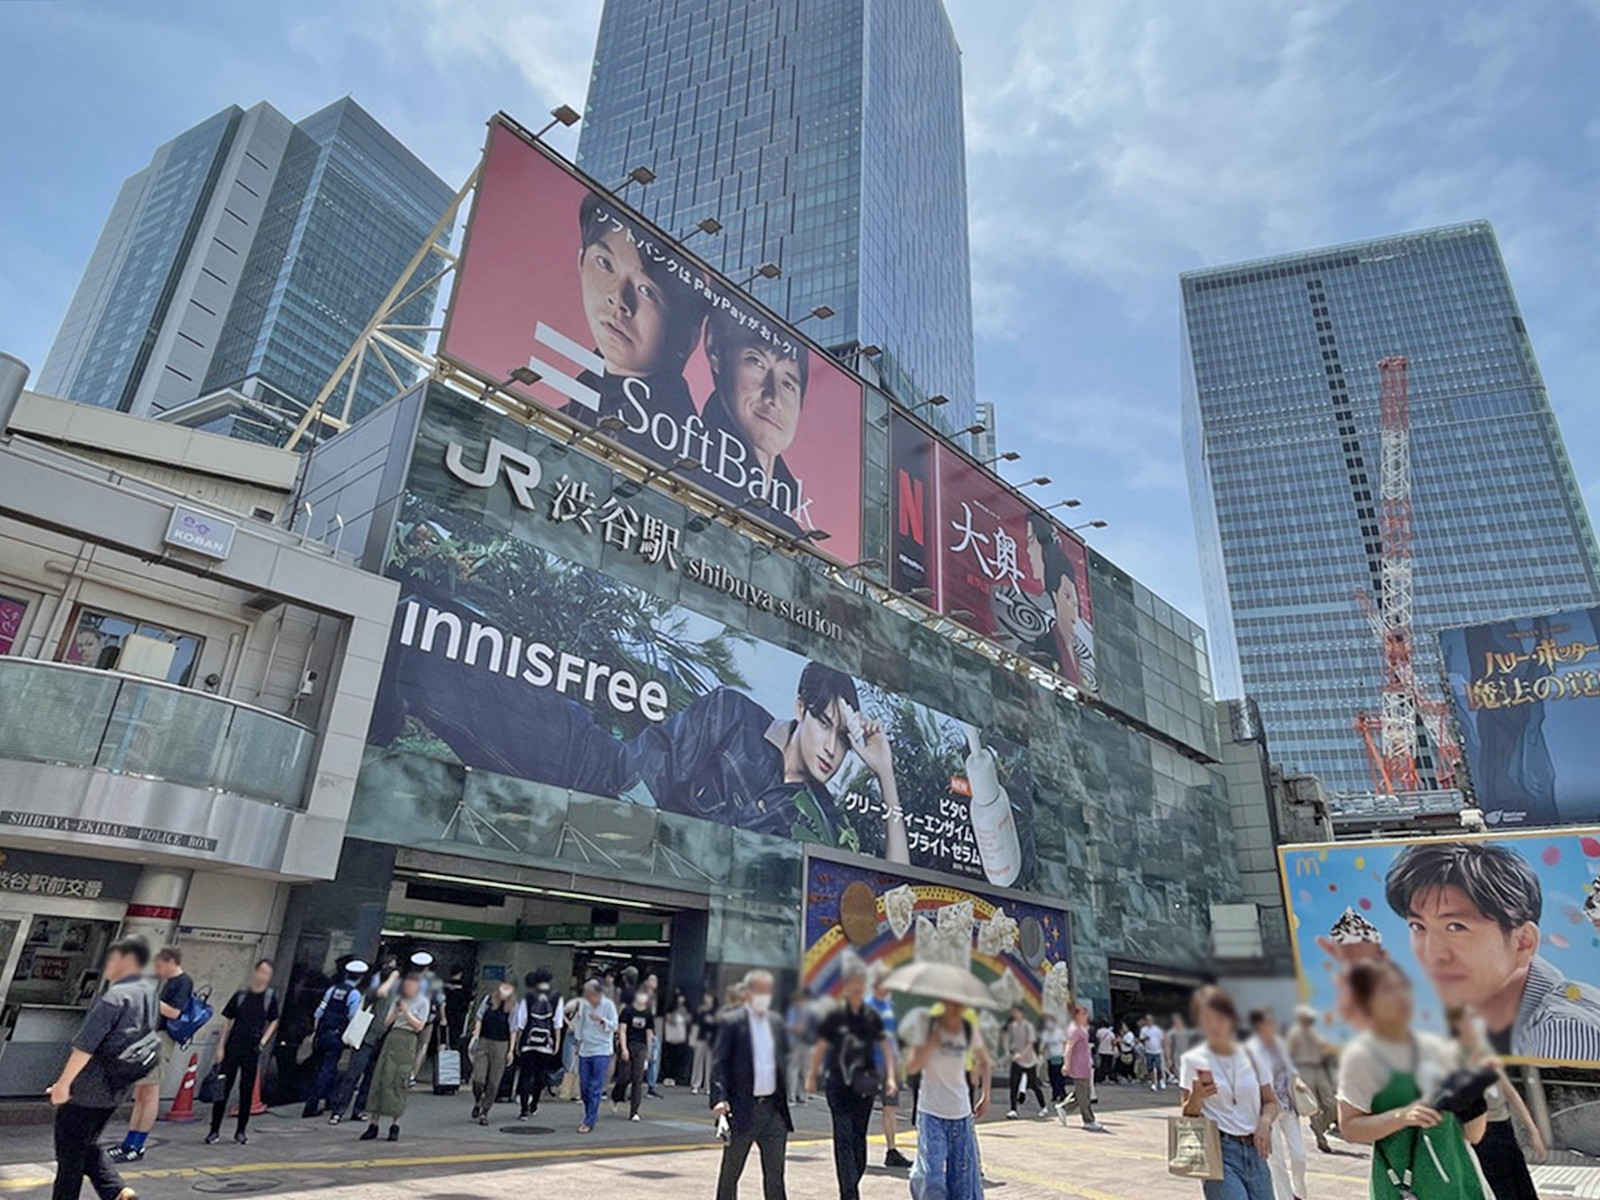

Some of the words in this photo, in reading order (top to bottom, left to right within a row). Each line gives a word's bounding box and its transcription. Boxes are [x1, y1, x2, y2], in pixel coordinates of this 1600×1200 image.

[445, 437, 543, 511] JR
[617, 376, 814, 530] SoftBank
[173, 528, 224, 552] KOBAN
[549, 473, 681, 570] 渋谷駅
[949, 500, 1027, 596] 大奥
[686, 557, 775, 611] shibuya
[777, 597, 844, 641] station
[8, 813, 128, 838] SHIBUYA-EKIMAE
[138, 828, 182, 846] POLICE
[187, 836, 211, 850] BOX
[845, 791, 975, 844] グリーンティーエンザイム
